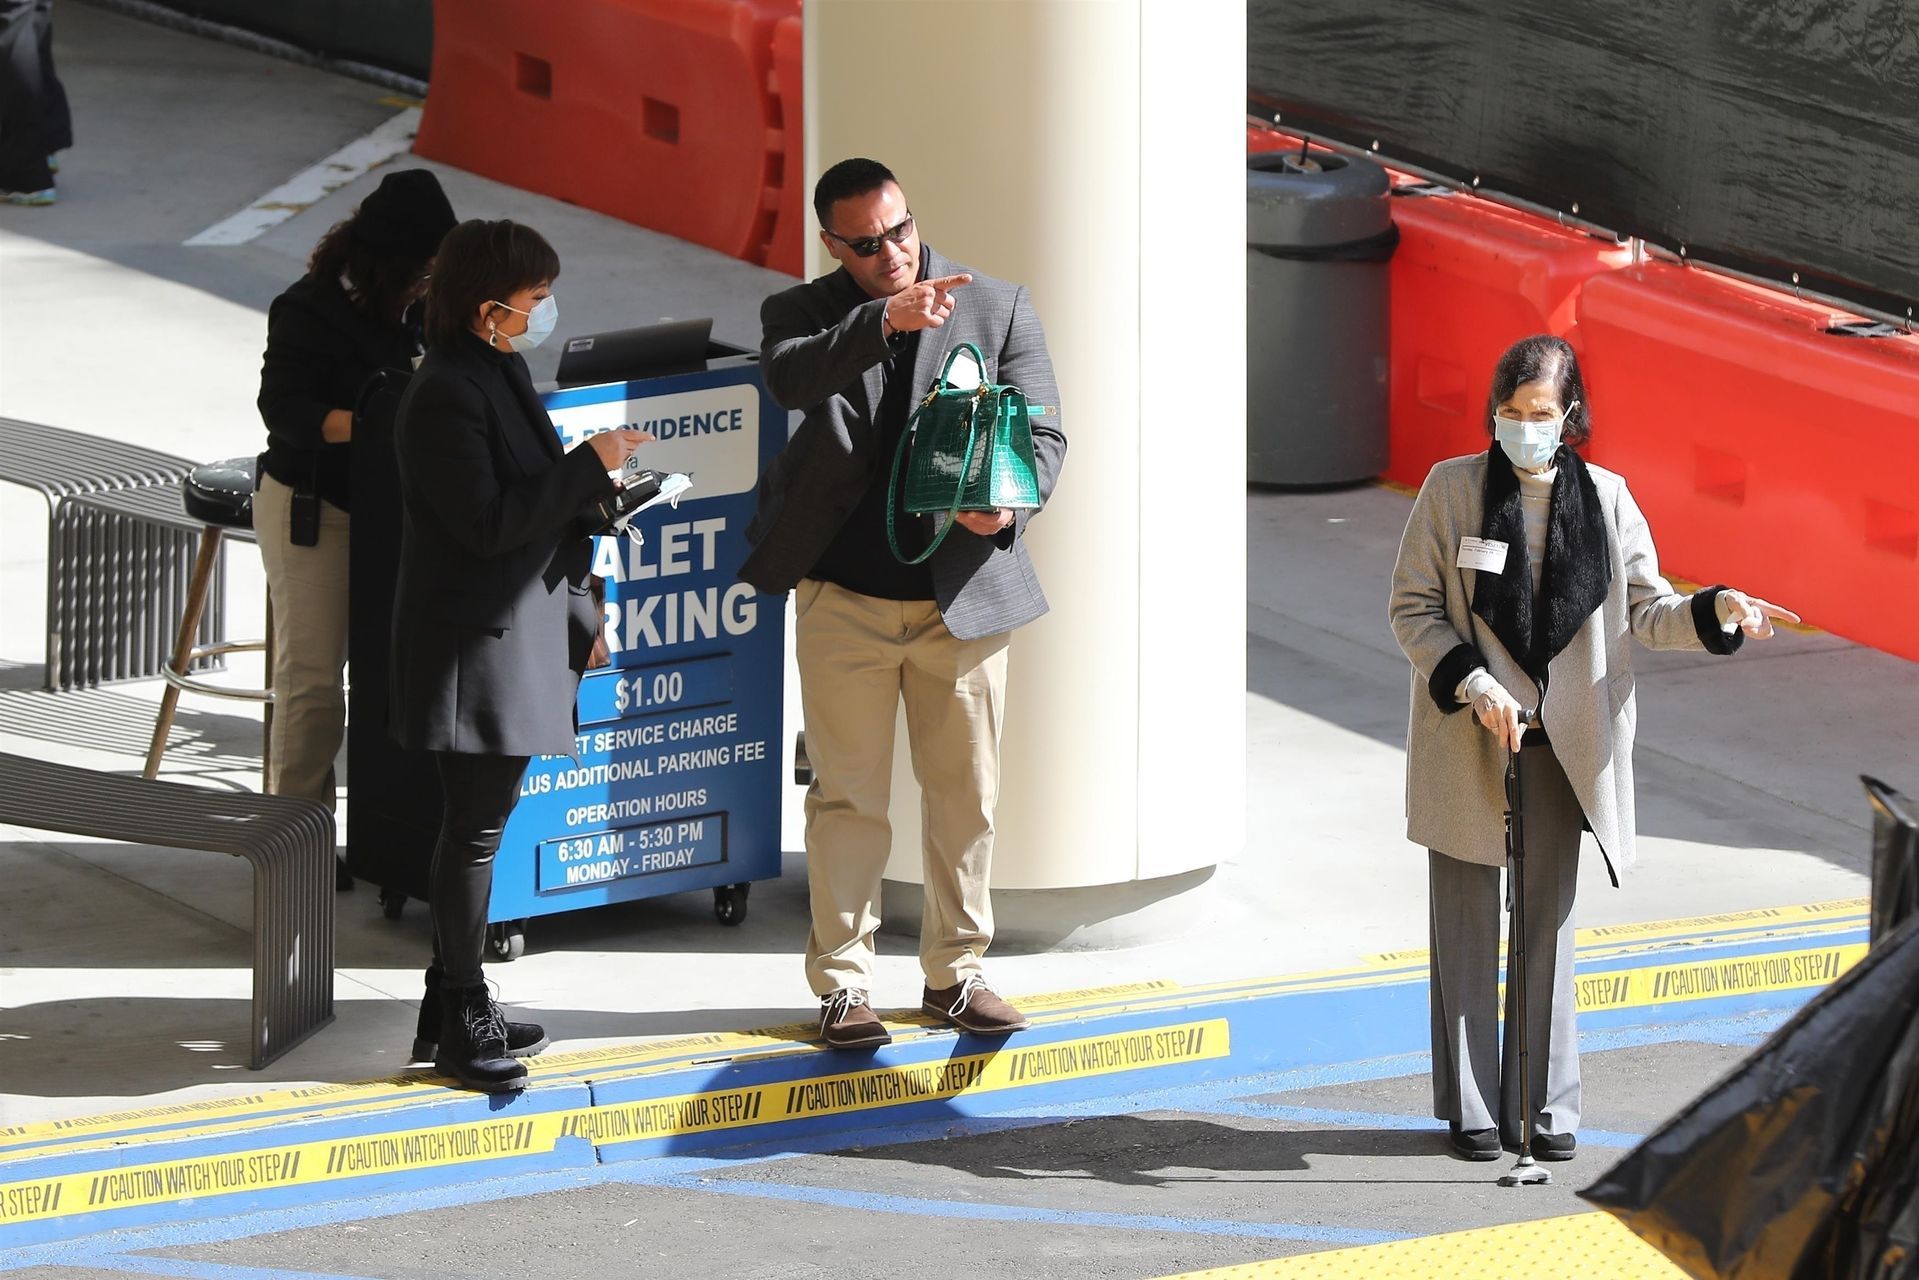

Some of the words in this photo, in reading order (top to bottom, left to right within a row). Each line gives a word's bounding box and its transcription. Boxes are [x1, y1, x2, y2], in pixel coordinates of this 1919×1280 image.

[583, 409, 742, 441] IDENCE
[592, 517, 726, 584] ALET
[603, 582, 757, 653] RKING
[615, 672, 683, 712] $1.00
[594, 725, 664, 752] SERVICE
[668, 714, 737, 741] CHARGE
[520, 774, 551, 796] LUS
[555, 760, 653, 790] ADDITIONAL
[658, 747, 731, 774] PARKING
[734, 741, 765, 763] FEE
[566, 801, 651, 825] OPERATION
[655, 789, 707, 812] HOURS
[558, 839, 593, 862] 6:30
[597, 834, 624, 856] AM
[639, 827, 672, 850] 5:30
[678, 821, 703, 843] PM
[566, 858, 630, 884] MONDAY
[642, 848, 695, 871] FRIDAY
[1582, 978, 1611, 1006] STEP
[1671, 966, 1719, 996] CAUTION
[1720, 961, 1760, 989] WATCH
[1760, 957, 1791, 985] YOUR
[1793, 955, 1822, 981] STEP
[1028, 1047, 1079, 1078] CAUTION
[1079, 1040, 1122, 1070] WATCH
[1121, 1036, 1154, 1063] YOUR
[1157, 1030, 1186, 1059] STEP
[807, 1079, 857, 1110] CAUTION
[858, 1073, 901, 1104] WATCH
[901, 1068, 934, 1097] YOUR
[936, 1063, 966, 1091] STEP
[579, 1109, 629, 1140] CAUTION
[634, 1103, 677, 1132] WATCH
[677, 1098, 711, 1128] YOUR
[712, 1093, 743, 1123] STEP
[347, 1140, 399, 1170] CAUTION
[400, 1133, 445, 1164] WATCH
[445, 1128, 479, 1157] YOUR
[483, 1123, 515, 1153] STEP
[110, 1169, 163, 1201] CAUTION
[165, 1163, 209, 1194] WATCH
[210, 1158, 246, 1187] YOUR
[248, 1153, 280, 1182] STEP
[9, 1185, 41, 1217] STEP
